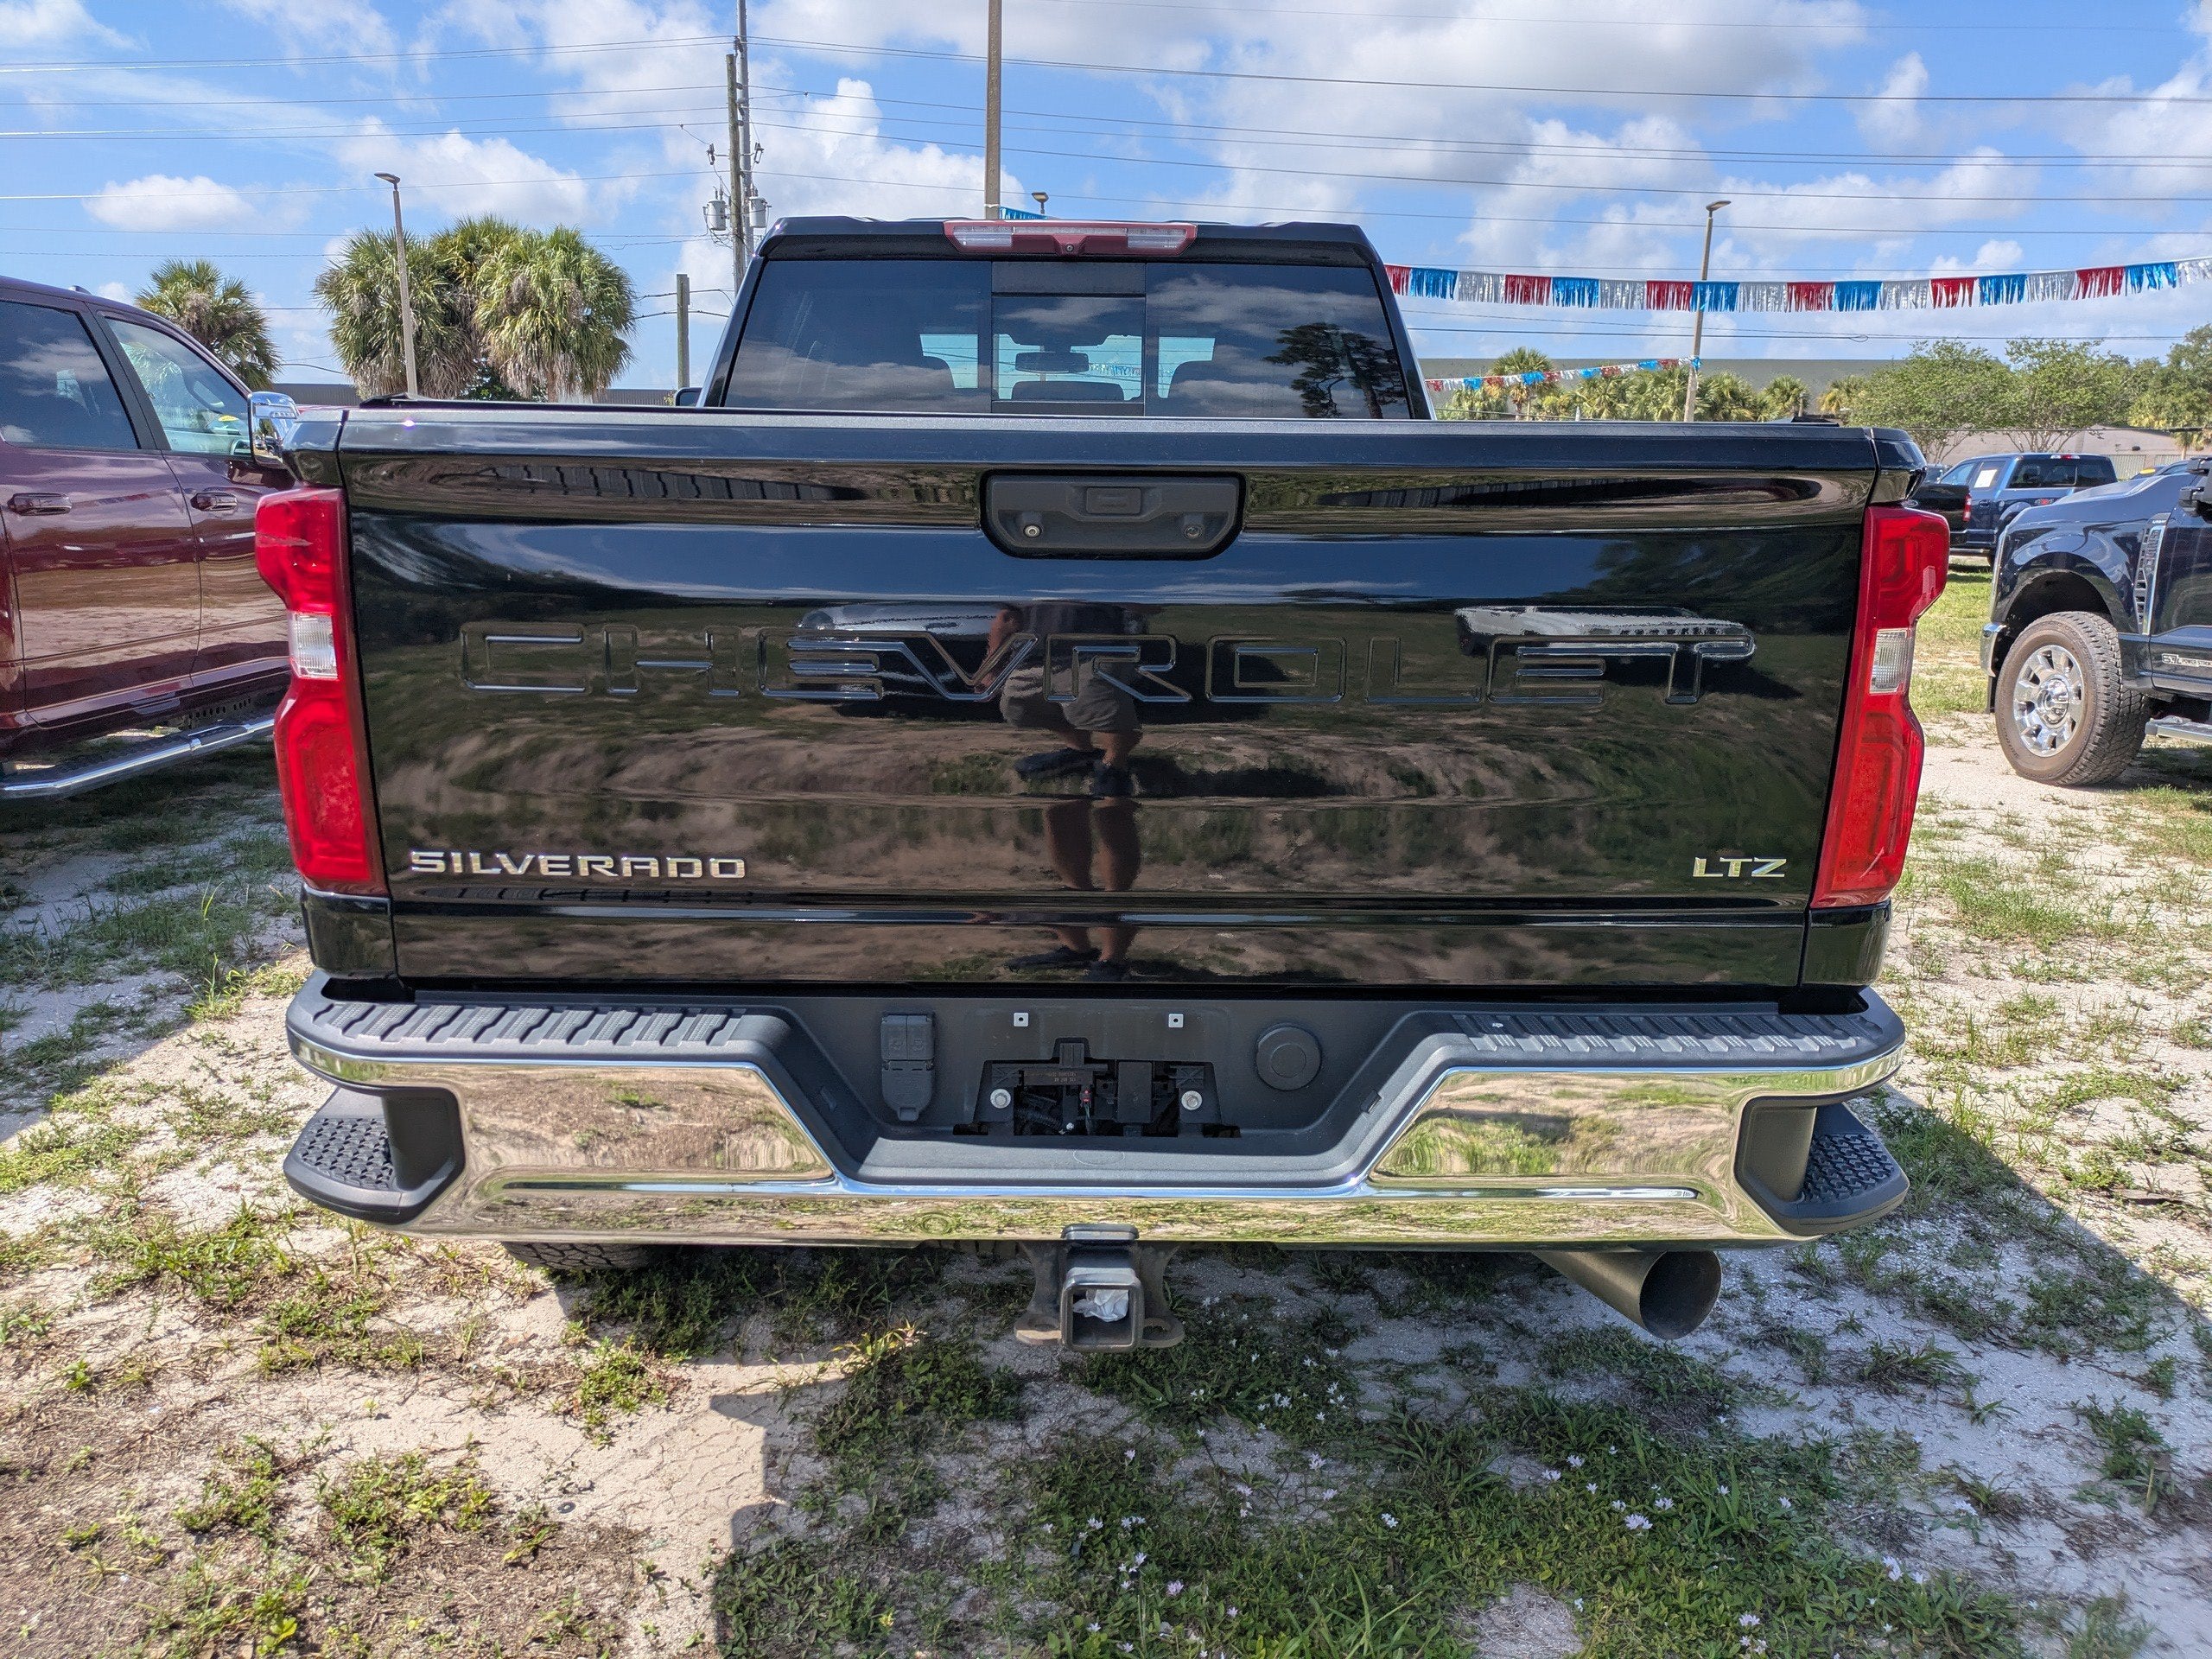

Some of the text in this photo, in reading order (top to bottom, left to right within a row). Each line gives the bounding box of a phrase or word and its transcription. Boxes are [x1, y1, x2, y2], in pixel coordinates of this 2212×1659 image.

[459, 621, 1756, 704] CHEVROLET
[410, 851, 746, 879] SILVERADO
[1693, 857, 1787, 877] LTZ
